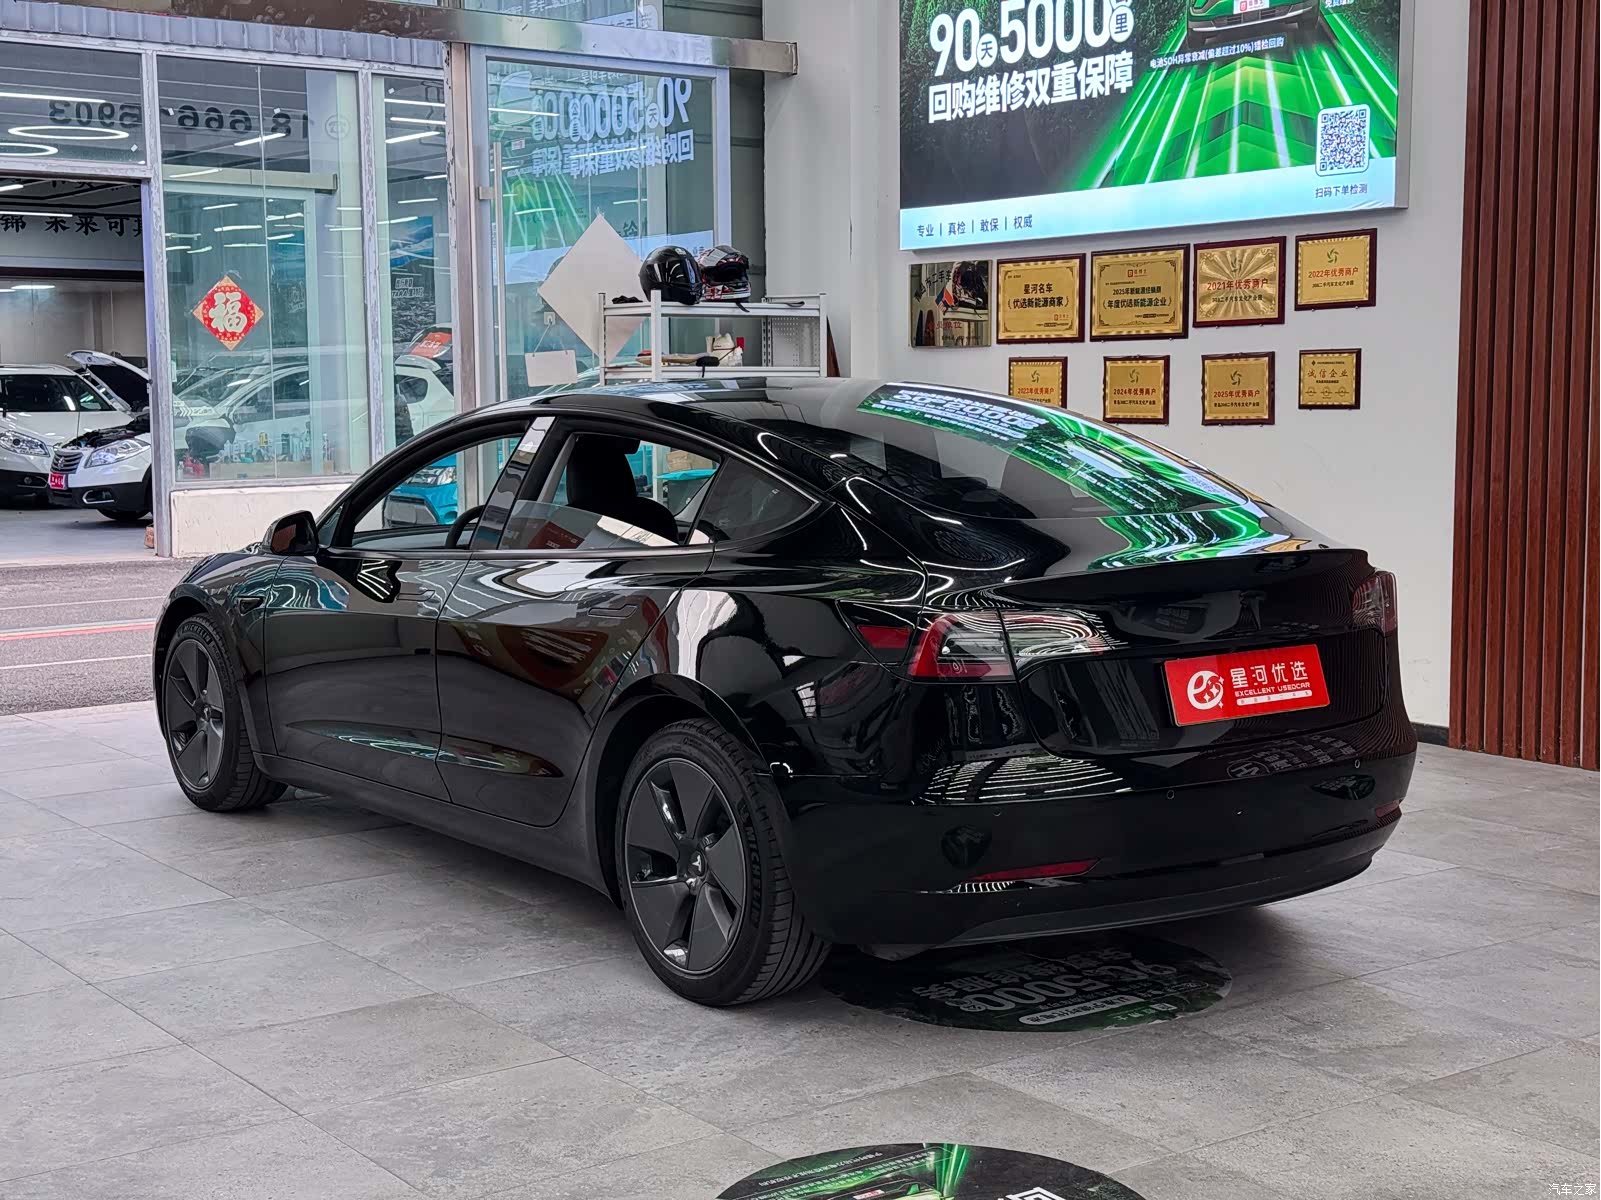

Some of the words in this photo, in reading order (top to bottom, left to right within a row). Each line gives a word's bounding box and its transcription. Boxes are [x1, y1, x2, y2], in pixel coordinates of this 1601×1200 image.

[928, 50, 1134, 124] 回购维修双重保障
[1315, 183, 1368, 199] 扫码下单检测
[917, 224, 935, 237] 专业
[948, 221, 966, 236] 真检
[980, 218, 999, 232] 敢保
[1013, 214, 1033, 229] 权威
[1308, 266, 1359, 279] 2022年优秀商户
[1023, 282, 1054, 295] 星河名车
[1207, 278, 1268, 291] 2021年优秀商户
[208, 291, 248, 333] 福
[1307, 368, 1349, 379] 诚信企业
[1113, 387, 1157, 396] 2024年优秀商户
[1213, 389, 1260, 398] 2025年优秀商户
[184, 623, 211, 646] MICHELIN
[1230, 660, 1309, 689] 星河优选
[1235, 687, 1275, 698] EXCELLENT
[1277, 682, 1311, 692] USEDCAR
